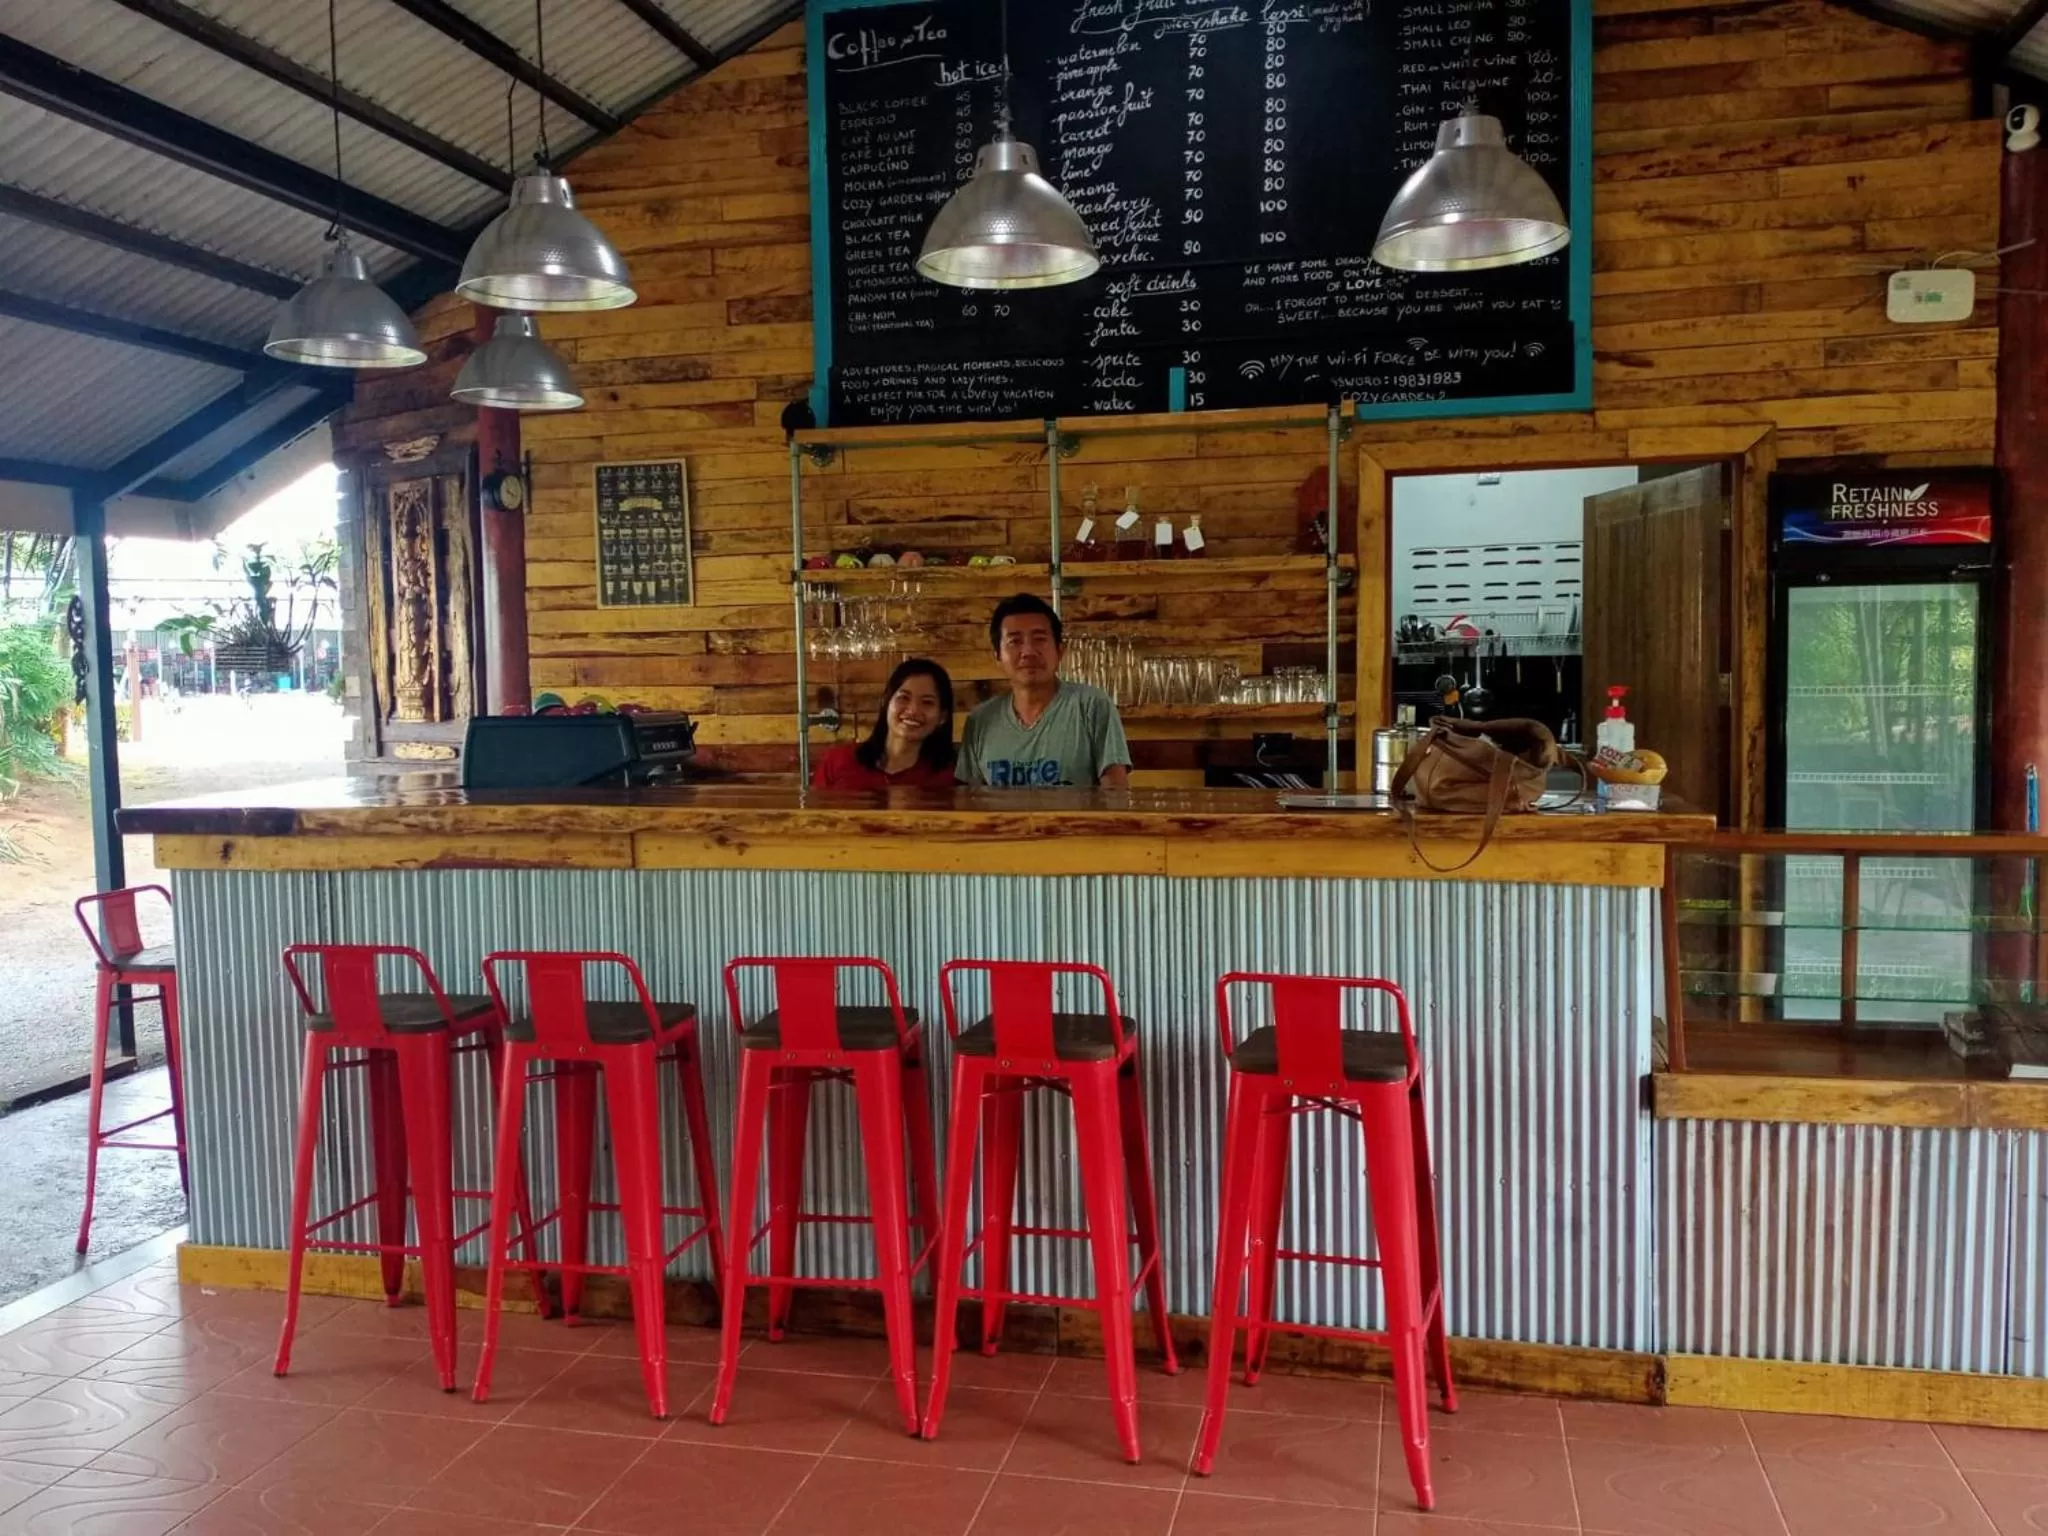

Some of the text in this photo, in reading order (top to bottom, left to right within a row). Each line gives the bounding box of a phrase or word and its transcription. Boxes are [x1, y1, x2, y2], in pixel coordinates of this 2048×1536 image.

[1403, 4, 1442, 18] SMALL
[912, 14, 947, 42] Tea
[1403, 20, 1471, 35] SMALL LEO
[1057, 22, 1285, 66] watermelon 70 80
[1189, 47, 1207, 58] 70
[1266, 37, 1286, 52] 80
[1403, 39, 1442, 50] SMALL
[939, 60, 971, 83] hot
[1403, 63, 1426, 74] RED
[1485, 54, 1517, 66] WINE
[1061, 54, 1285, 109] orange 70 80
[1401, 83, 1432, 95] THAI
[956, 104, 971, 117] 45
[1056, 72, 1286, 134] passion fruit 70 80
[1402, 104, 1426, 116] GIN
[956, 122, 973, 136] 50
[1060, 97, 1286, 144] carrot 70 80
[1404, 121, 1429, 133] RUM
[955, 138, 972, 150] 60
[1061, 116, 1286, 171] mango 70 80
[955, 152, 973, 164] 60
[1060, 138, 1285, 181] lime 70 80
[1184, 170, 1203, 183] 70
[1264, 157, 1285, 173] 80
[1185, 177, 1285, 200] 70 80
[843, 191, 924, 216] COZY GARDEN
[1182, 208, 1204, 224] 90
[1260, 199, 1287, 212] 100
[845, 230, 911, 246] BLACK TEA
[1183, 240, 1201, 255] 90
[1259, 231, 1286, 245] 100
[888, 245, 911, 257] TEA
[890, 261, 910, 272] TEA
[1244, 264, 1260, 275] WE
[1267, 261, 1297, 273] HAVE
[1300, 258, 1328, 270] SOME
[1104, 270, 1200, 301] soft drinks
[1242, 276, 1266, 288] AND
[1270, 273, 1300, 285] MORE
[1303, 270, 1333, 282] FOOD
[1327, 277, 1383, 293] OF LOVE
[1284, 296, 1328, 309] FORGOT
[1333, 295, 1348, 305] TO
[1355, 290, 1405, 303] MENTION
[962, 304, 1010, 317] 60 70
[1093, 300, 1200, 319] coke 30
[1338, 305, 1390, 318] BECAUSE
[1397, 303, 1421, 323] YOU
[1453, 299, 1484, 312] WHAT
[1521, 298, 1547, 310] EAT
[1090, 320, 1202, 347] fanta 30
[1090, 350, 1201, 376] sprite 30
[1270, 353, 1295, 381] MAY
[1296, 354, 1321, 367] THE
[1373, 350, 1416, 367] FORCE
[1423, 348, 1441, 361] BE
[924, 375, 946, 385] AND
[1091, 370, 1206, 388] soda 30
[1093, 391, 1205, 411] water 15
[1831, 501, 1940, 520] FRESHNESS
